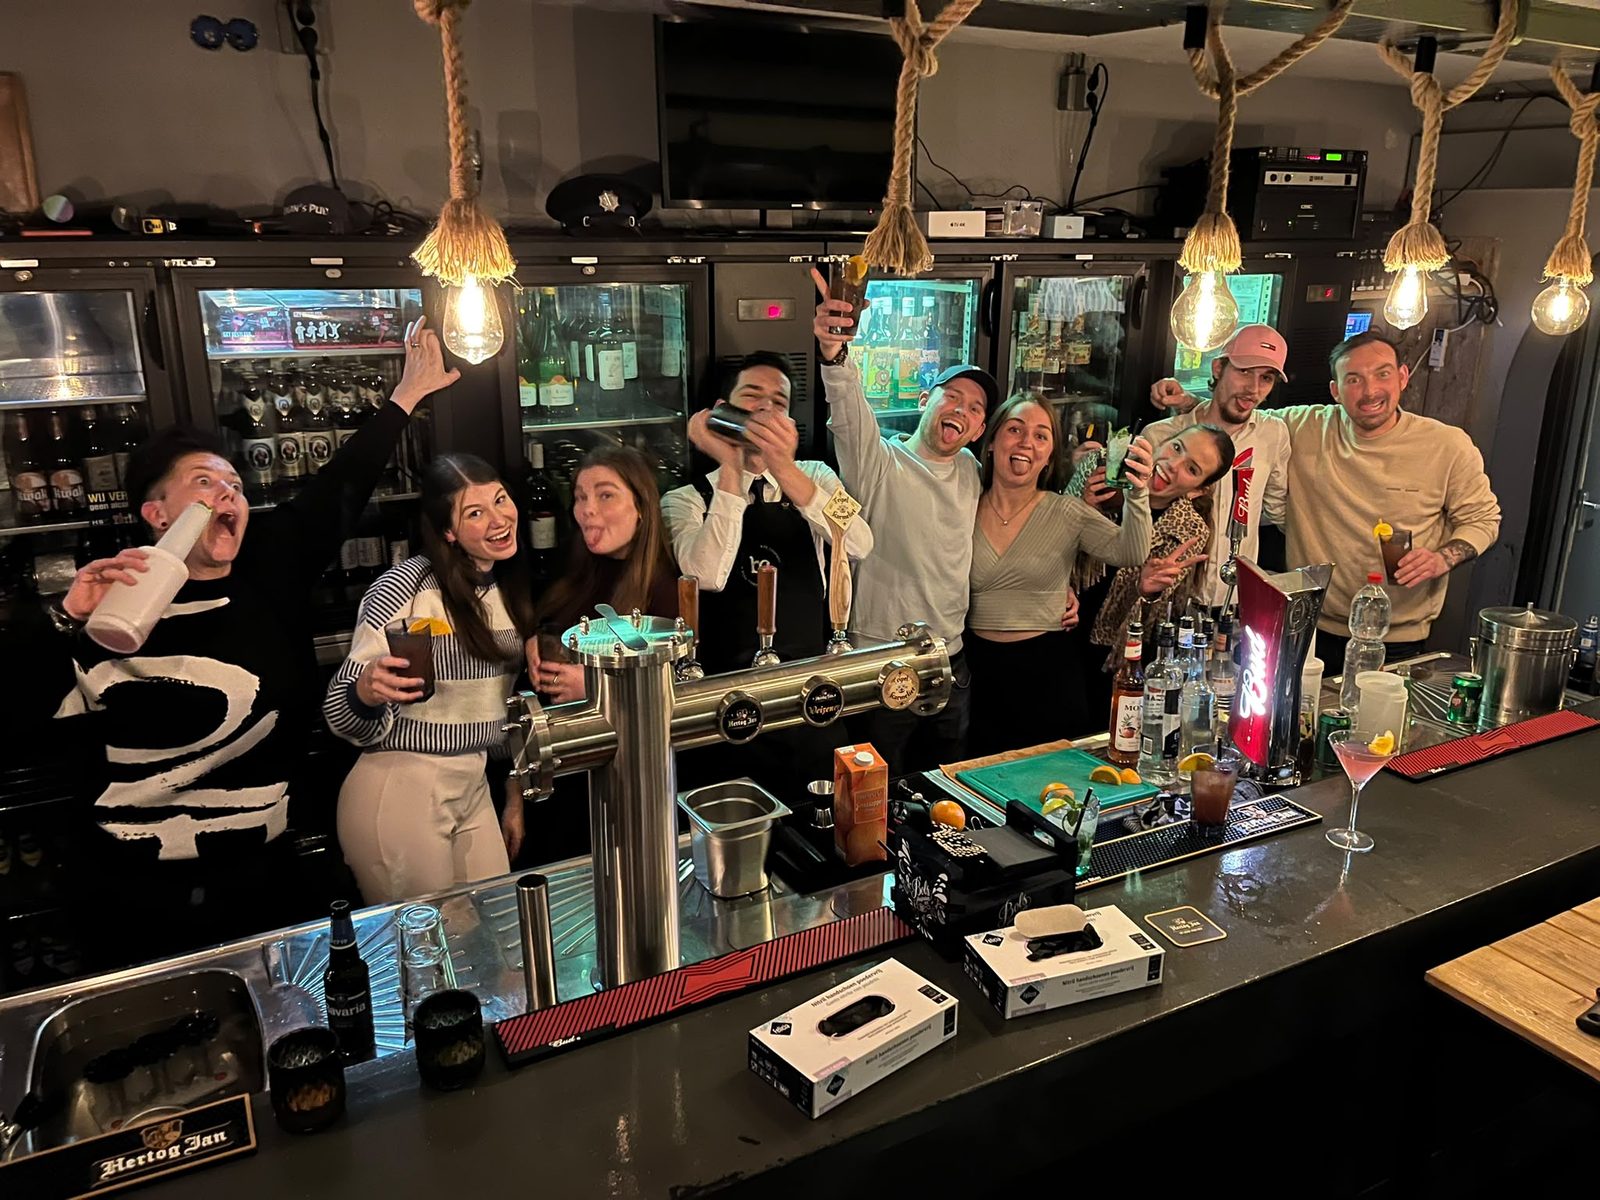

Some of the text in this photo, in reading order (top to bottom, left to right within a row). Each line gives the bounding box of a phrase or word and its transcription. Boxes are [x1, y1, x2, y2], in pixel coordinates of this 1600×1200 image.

[1237, 478, 1252, 517] Bud
[1240, 625, 1267, 719] Bud
[100, 1130, 228, 1180] Hertog Jan
